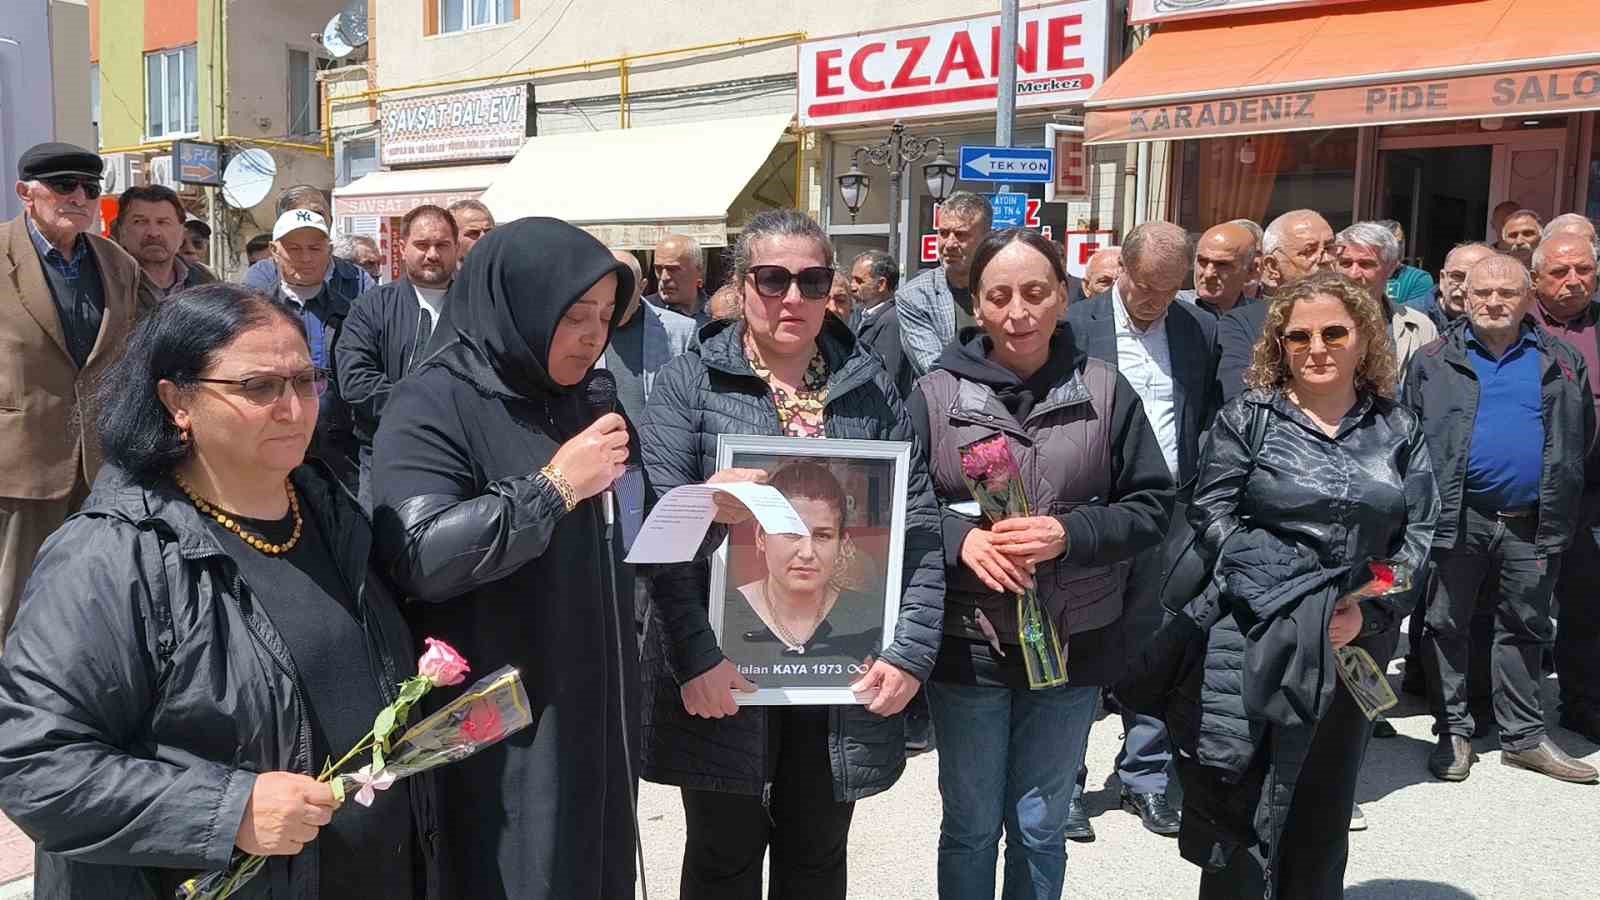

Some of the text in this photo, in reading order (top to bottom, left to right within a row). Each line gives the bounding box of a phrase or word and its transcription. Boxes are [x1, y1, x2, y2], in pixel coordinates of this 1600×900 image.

[815, 14, 1085, 98] ECZANE
[1017, 79, 1081, 94] Merkez
[451, 98, 483, 128] BAL
[990, 161, 1015, 170] TEK
[773, 664, 807, 674] KAYA
[812, 664, 843, 674] 1973
